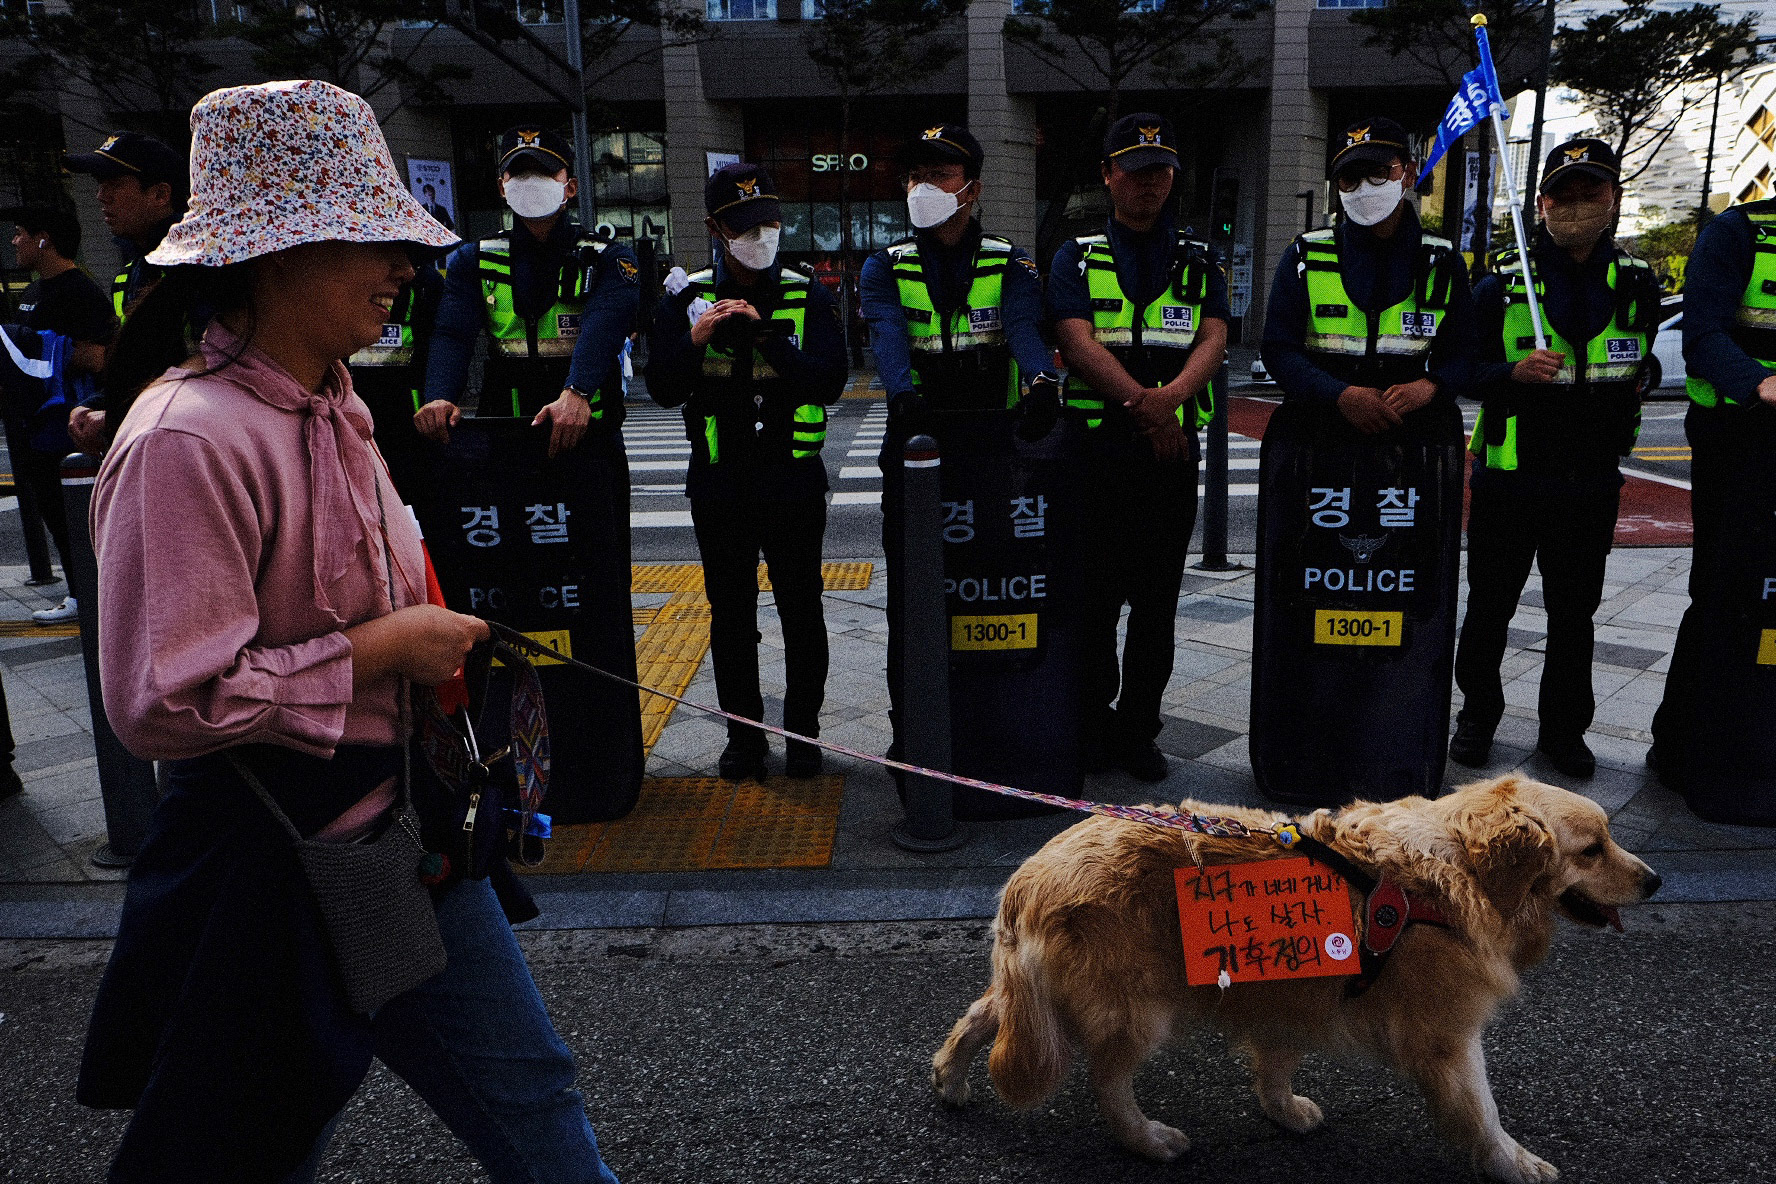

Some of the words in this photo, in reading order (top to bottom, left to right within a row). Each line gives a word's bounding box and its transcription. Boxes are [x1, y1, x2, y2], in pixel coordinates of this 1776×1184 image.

[1223, 223, 1232, 235] 4
[972, 322, 999, 330] POLICE
[1165, 320, 1190, 328] POLICE
[1610, 352, 1638, 360] POLICE
[1304, 567, 1415, 592] POLICE
[964, 621, 1026, 642] 1300-1
[1327, 618, 1391, 637] 1300-1
[1208, 909, 1259, 936] 나도
[1203, 935, 1321, 976] 기후정의
